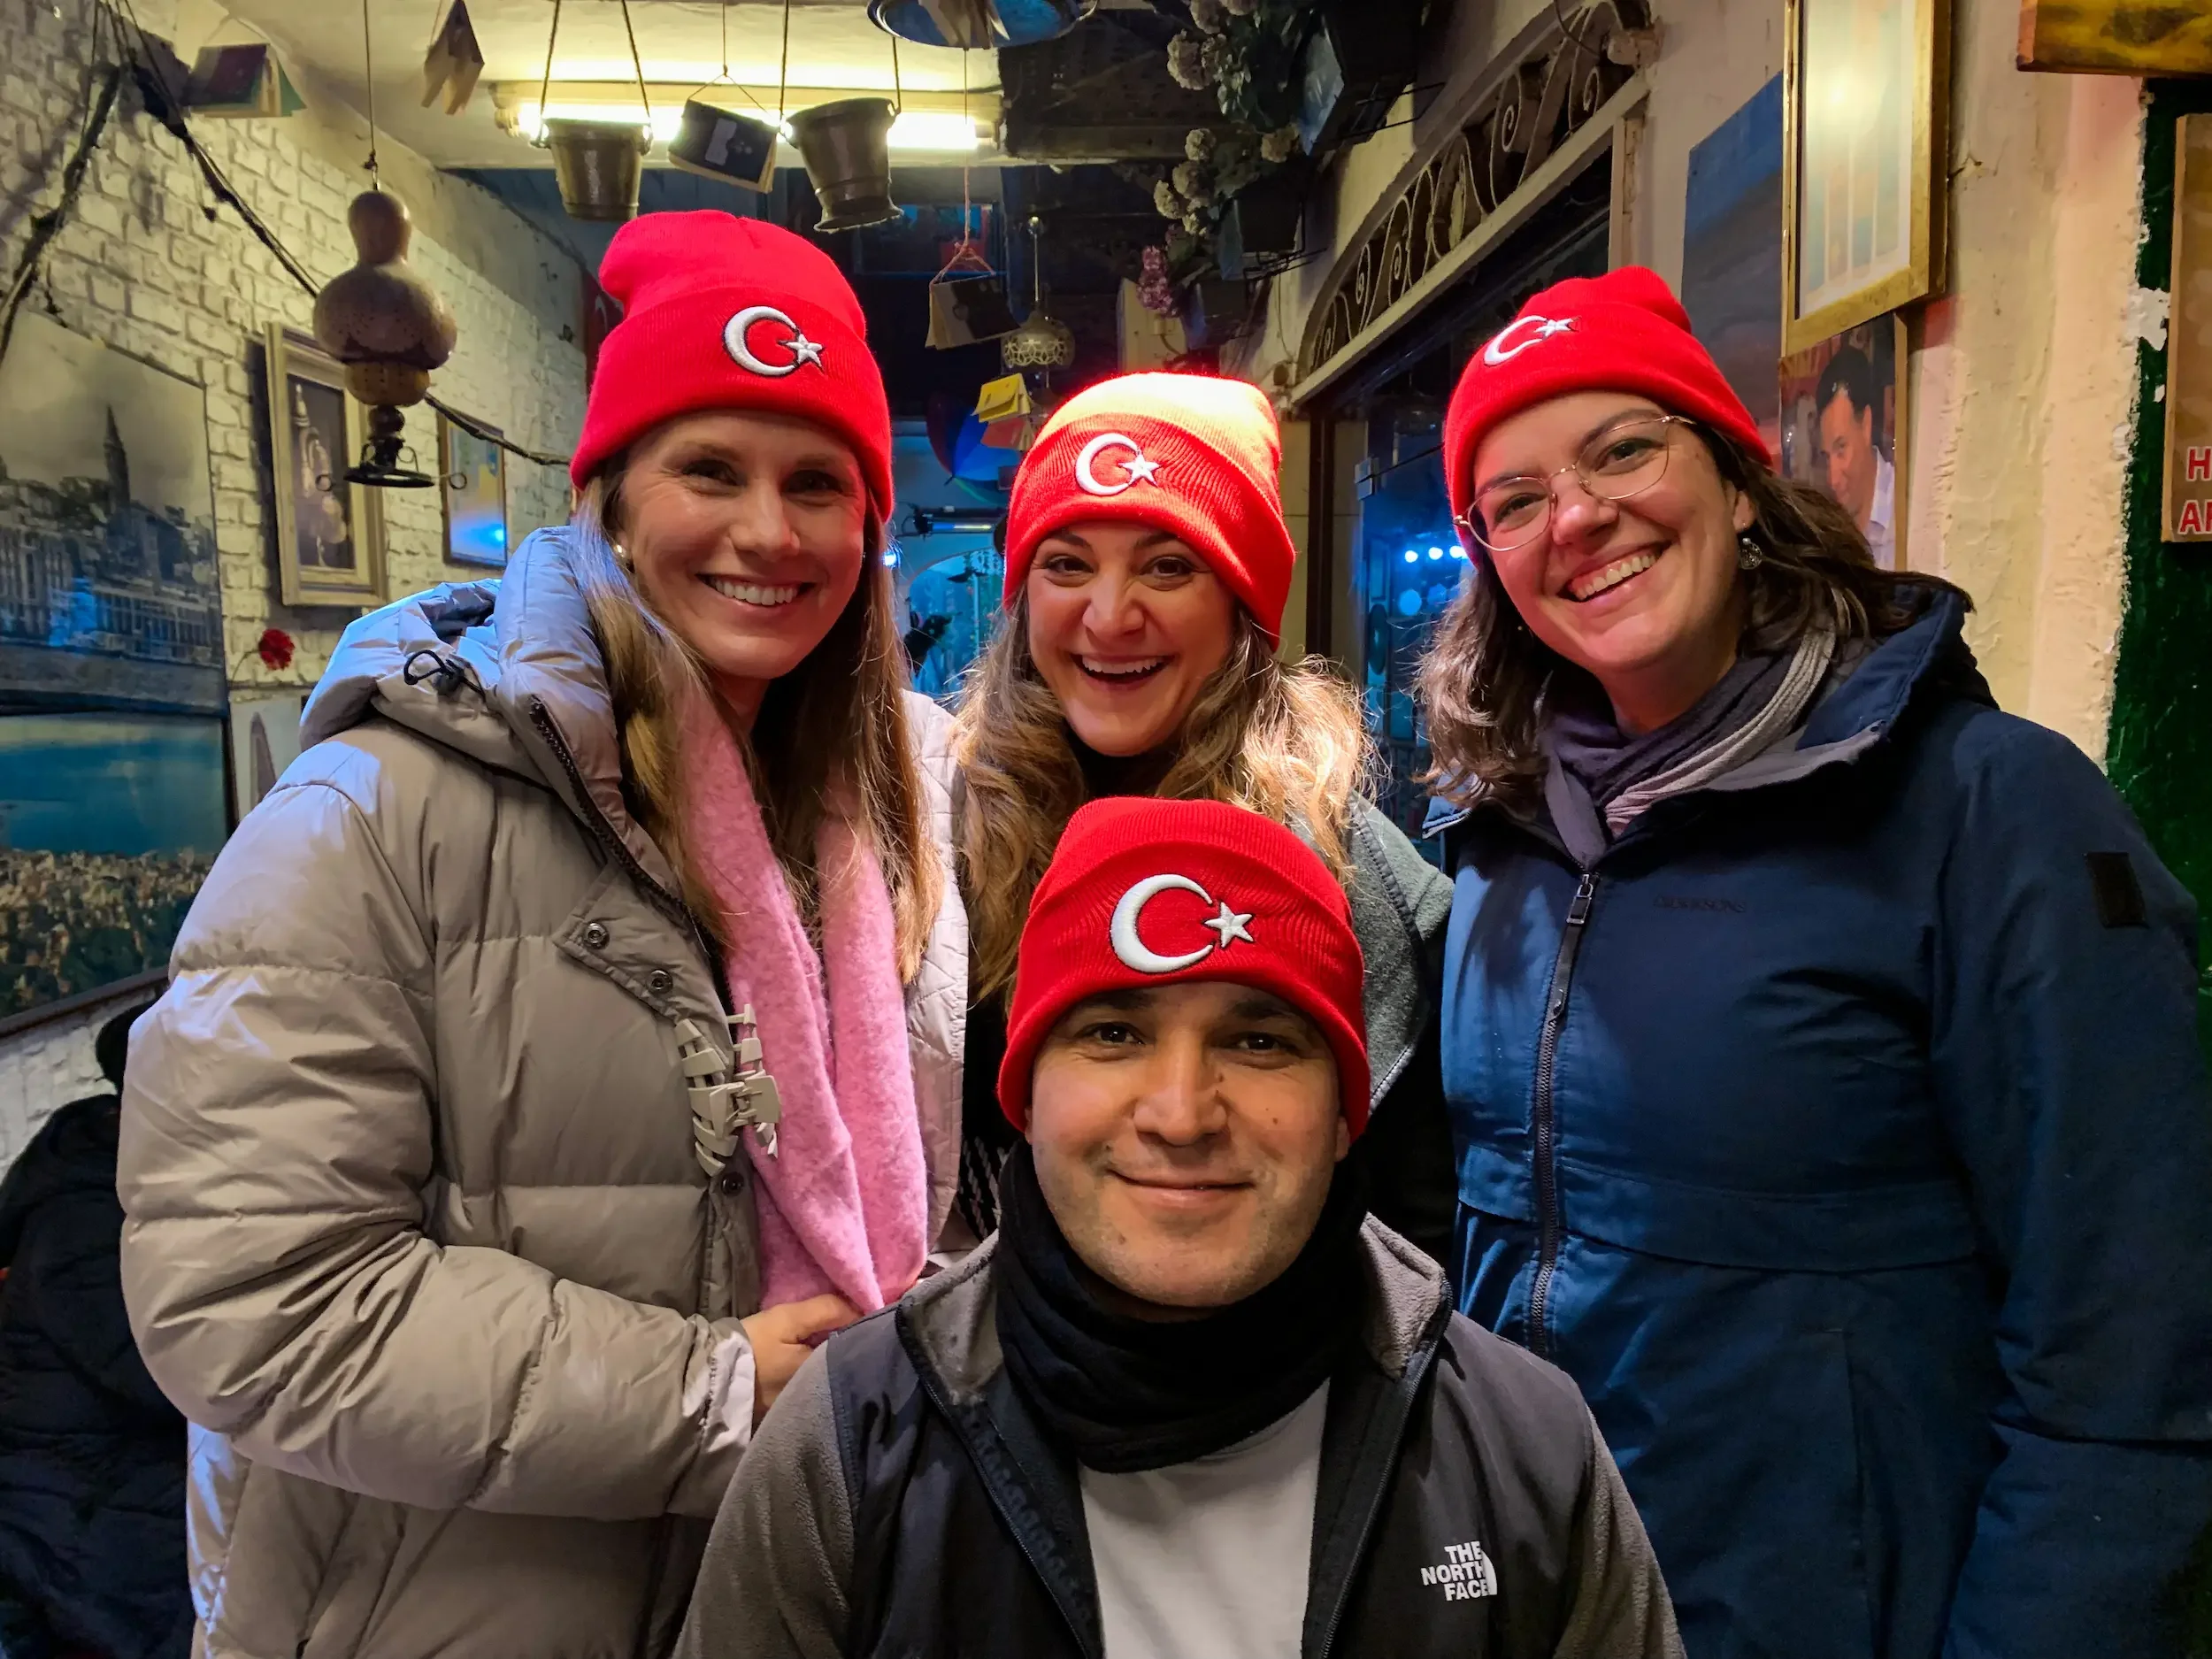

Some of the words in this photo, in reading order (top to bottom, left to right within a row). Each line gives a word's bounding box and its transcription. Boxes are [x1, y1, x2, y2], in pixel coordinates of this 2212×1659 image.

[1444, 1541, 1482, 1563] THE
[1421, 1561, 1485, 1586] NORTH
[1444, 1579, 1489, 1601] FACE
